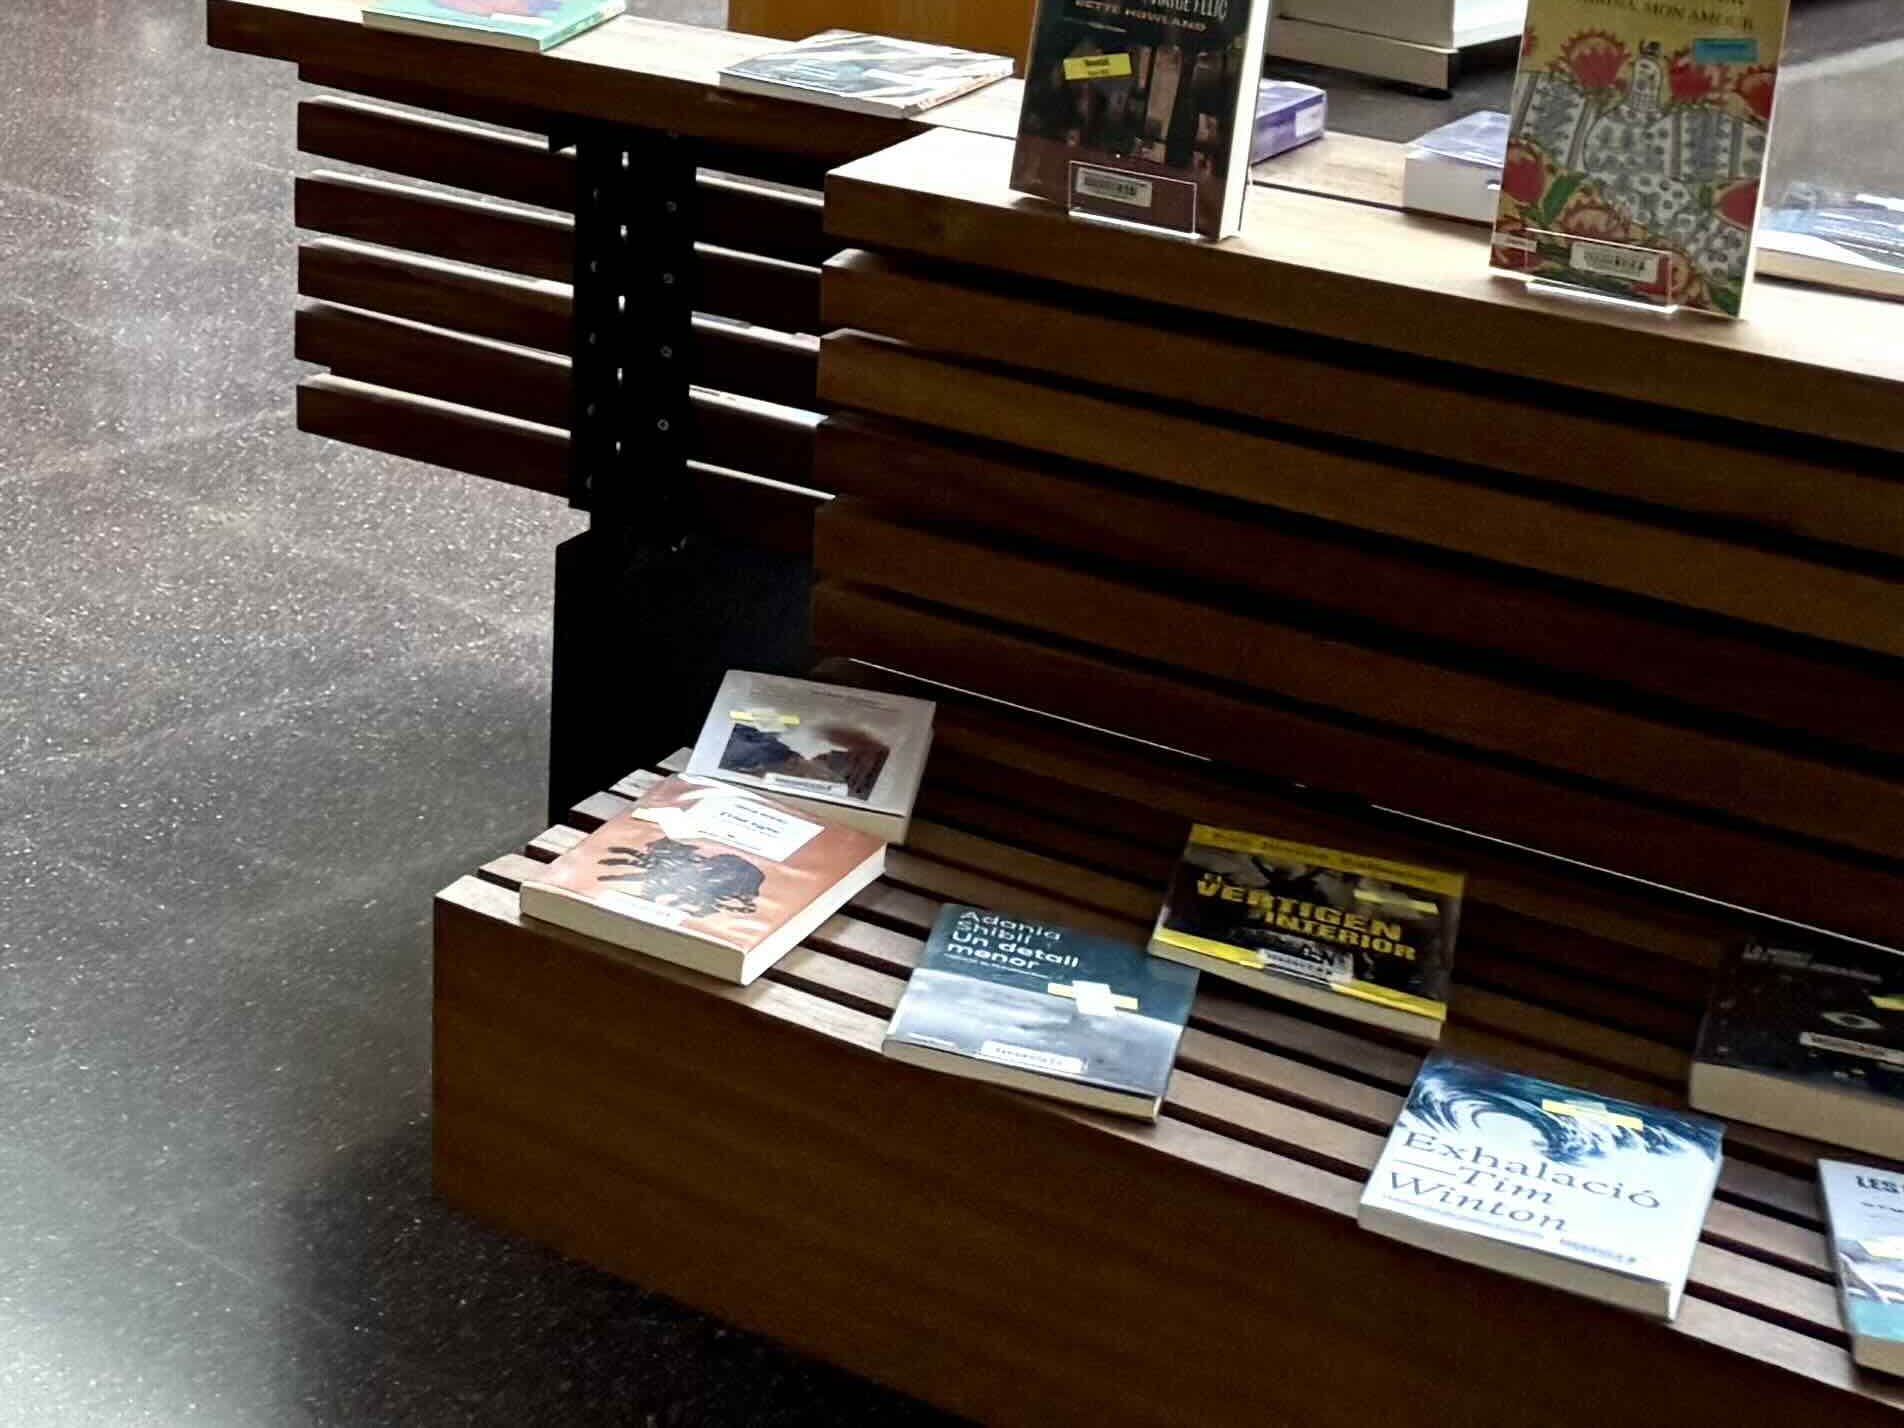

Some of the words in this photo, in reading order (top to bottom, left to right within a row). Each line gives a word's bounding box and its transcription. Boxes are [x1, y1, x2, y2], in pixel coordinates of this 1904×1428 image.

[960, 911, 1061, 941] Adania
[1197, 879, 1402, 941] VERTIGEN
[952, 930, 989, 947] Un
[998, 943, 1080, 968] detall
[956, 920, 1032, 945] Shibli
[1265, 910, 1417, 961] INTERIOR
[947, 943, 1041, 969] menor
[1403, 1130, 1661, 1210] Exhalació
[1459, 1165, 1554, 1205] Tim
[1391, 1171, 1569, 1232] Winton
